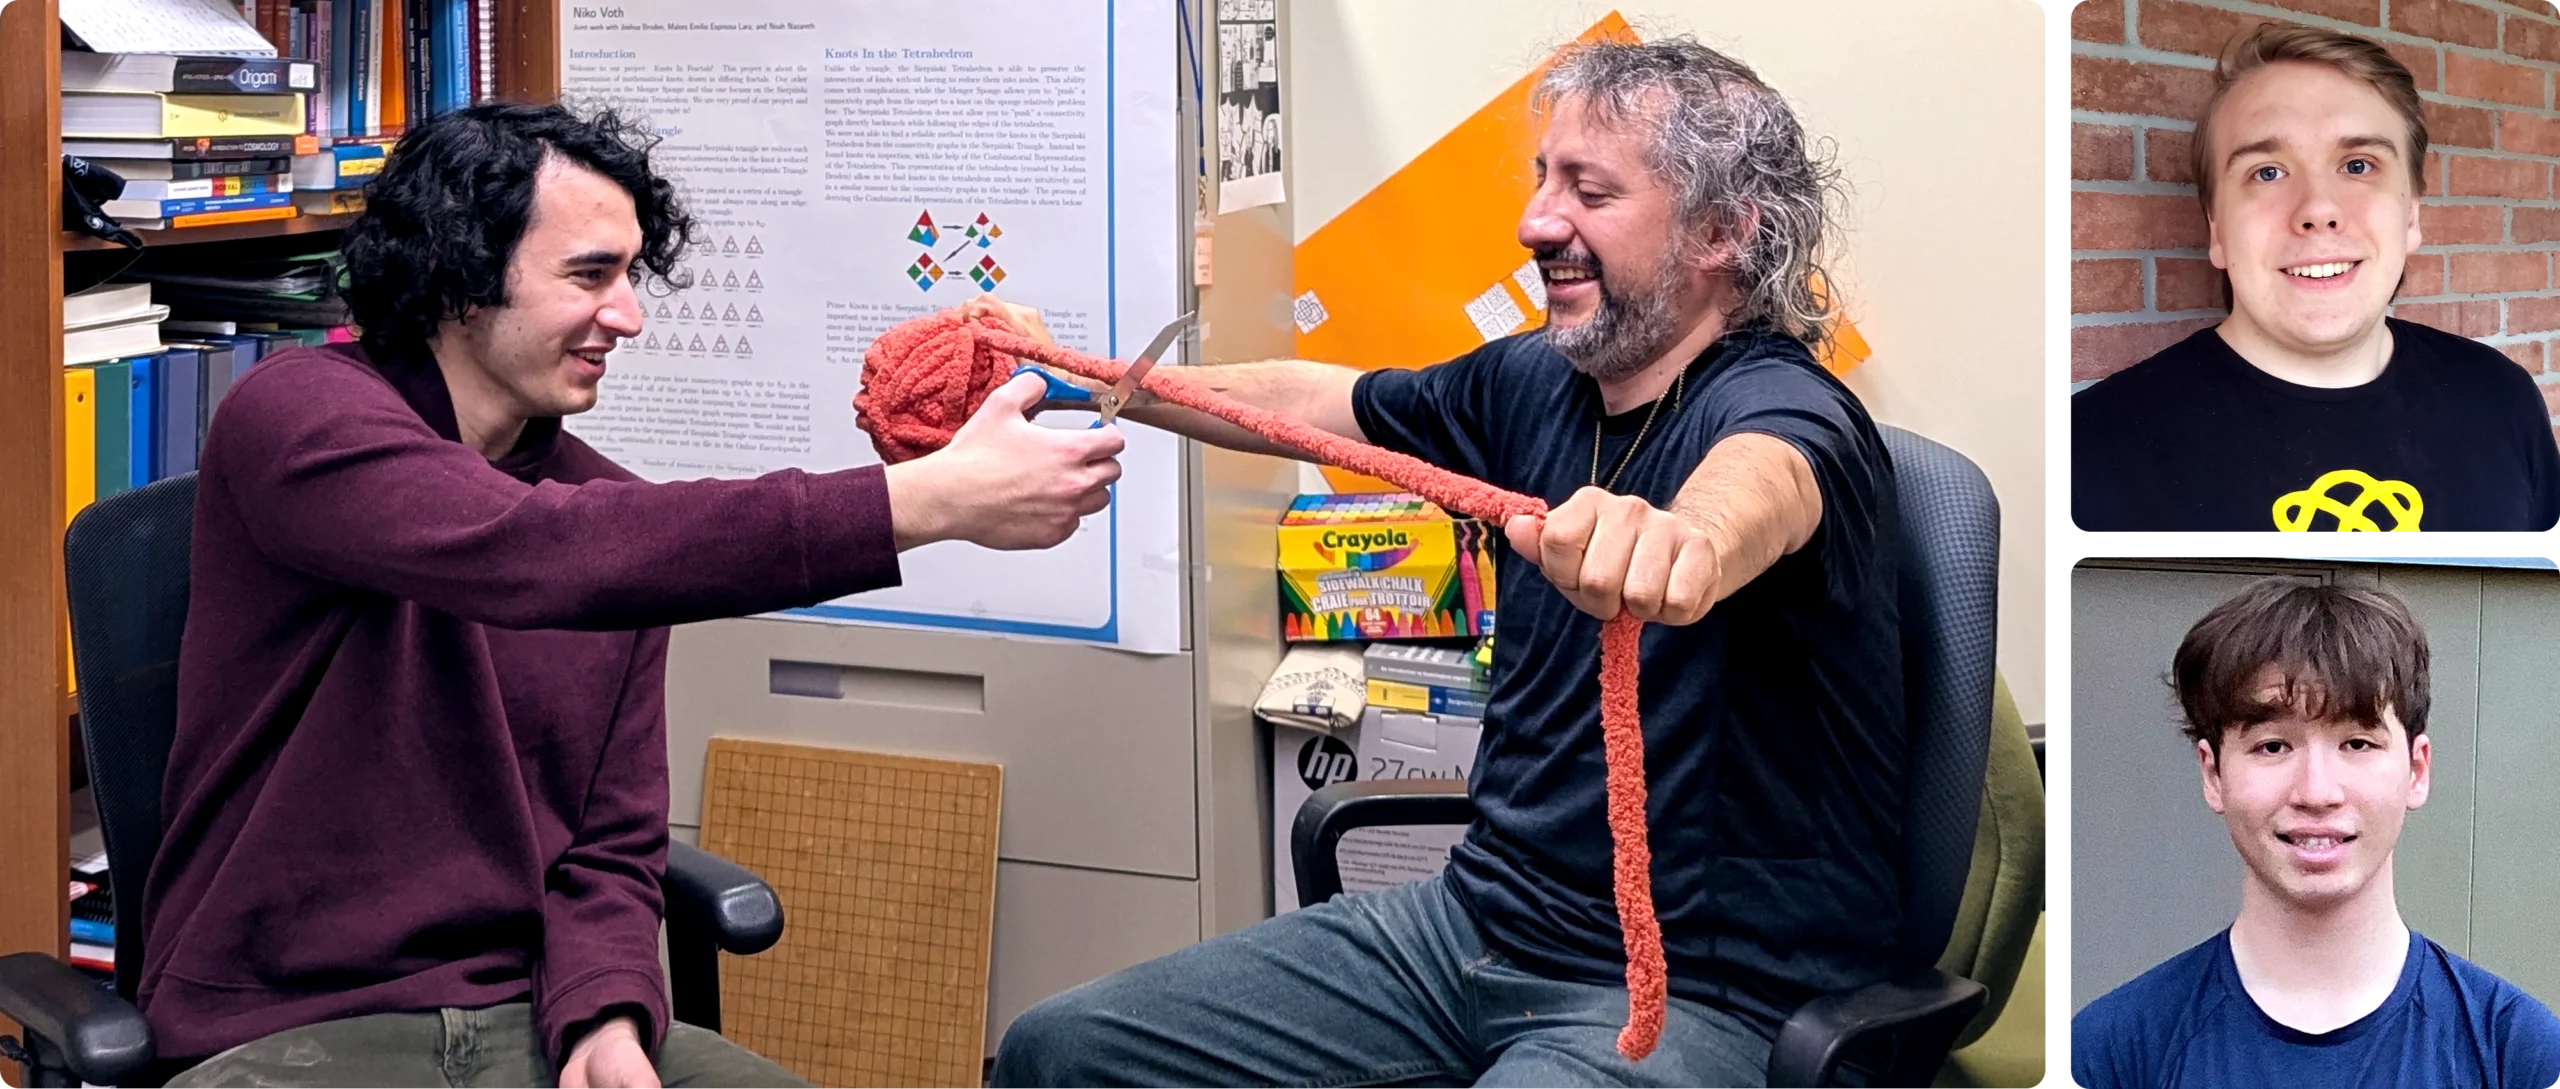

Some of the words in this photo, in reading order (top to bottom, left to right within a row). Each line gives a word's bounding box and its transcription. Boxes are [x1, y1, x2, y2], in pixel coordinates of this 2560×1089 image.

[573, 6, 597, 18] Niko
[600, 6, 624, 18] Voth
[569, 49, 636, 59] Introduction
[825, 48, 858, 59] Knots
[862, 48, 875, 59] In
[878, 48, 898, 59] the
[902, 48, 973, 59] Tetrahedron
[239, 68, 278, 88] Origami
[244, 142, 280, 151] COSMOLOGY
[1322, 528, 1408, 551] Crayola
[1318, 577, 1380, 593] SIDEWALK
[1382, 577, 1423, 593] CHALK
[1312, 593, 1348, 612] CRAIE
[1369, 592, 1432, 608] TROTTOIR
[1365, 607, 1381, 621] 64
[1304, 735, 1353, 787] hp
